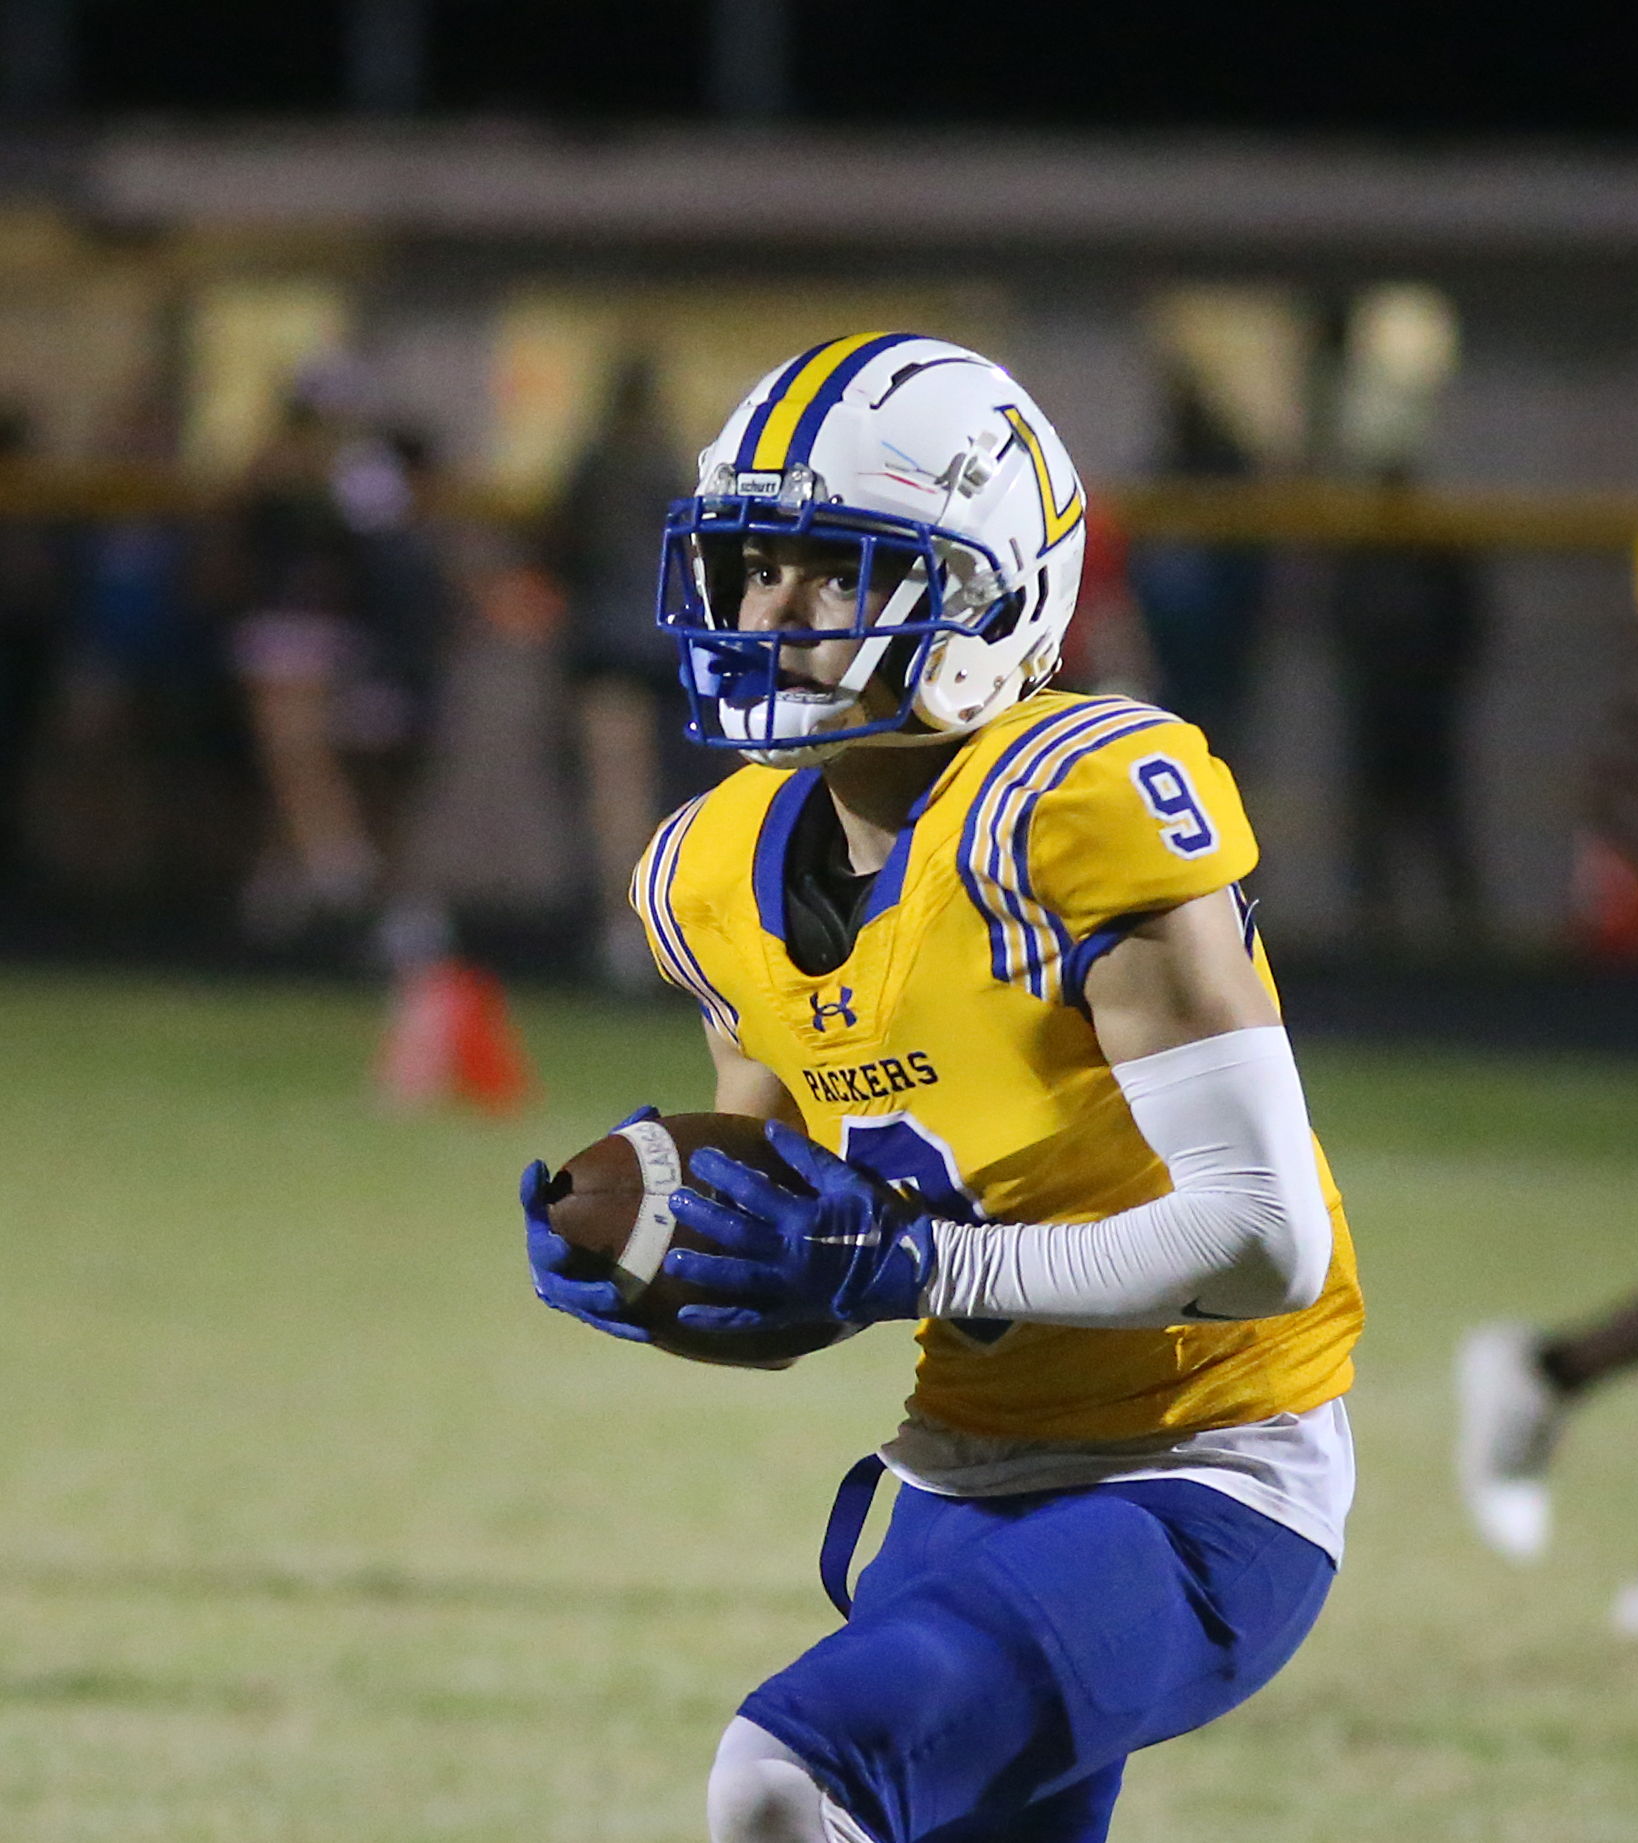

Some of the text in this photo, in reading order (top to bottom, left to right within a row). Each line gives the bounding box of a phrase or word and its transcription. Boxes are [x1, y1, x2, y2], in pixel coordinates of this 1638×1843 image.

[993, 404, 1083, 559] L
[1130, 752, 1219, 860] 9
[802, 1051, 938, 1102] PACKERS
